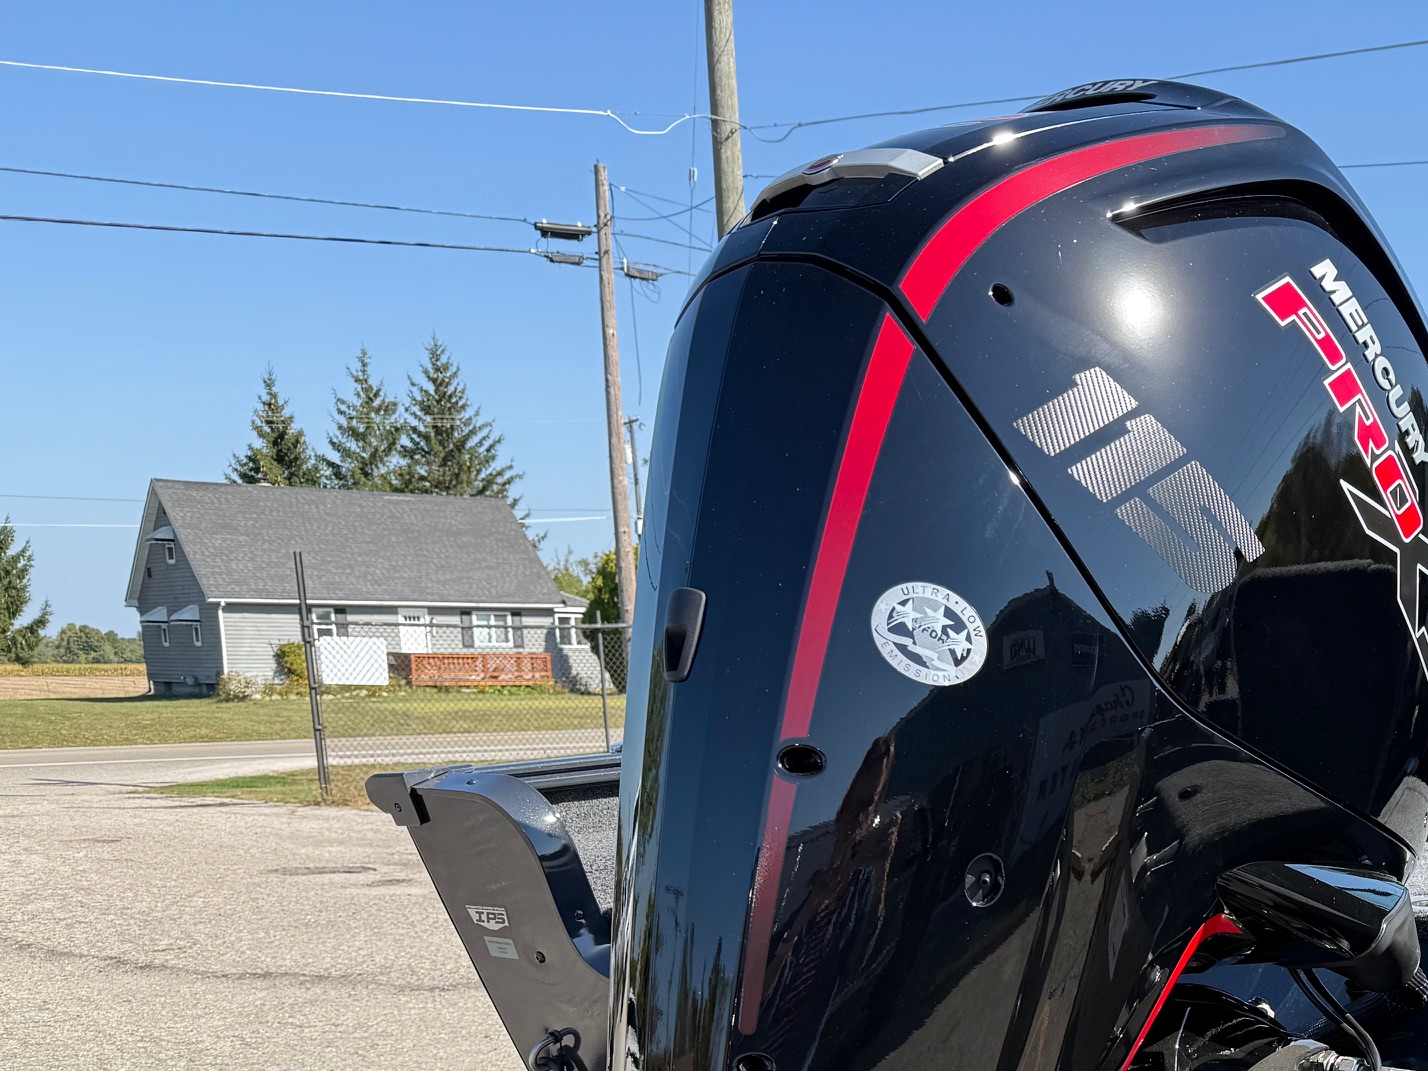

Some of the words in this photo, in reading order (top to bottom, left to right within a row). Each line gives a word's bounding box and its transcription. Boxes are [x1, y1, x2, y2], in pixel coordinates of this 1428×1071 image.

[1253, 274, 1424, 544] PRO
[1013, 366, 1266, 594] 115
[880, 641, 952, 683] EMISSION
[474, 910, 506, 925] IPS
